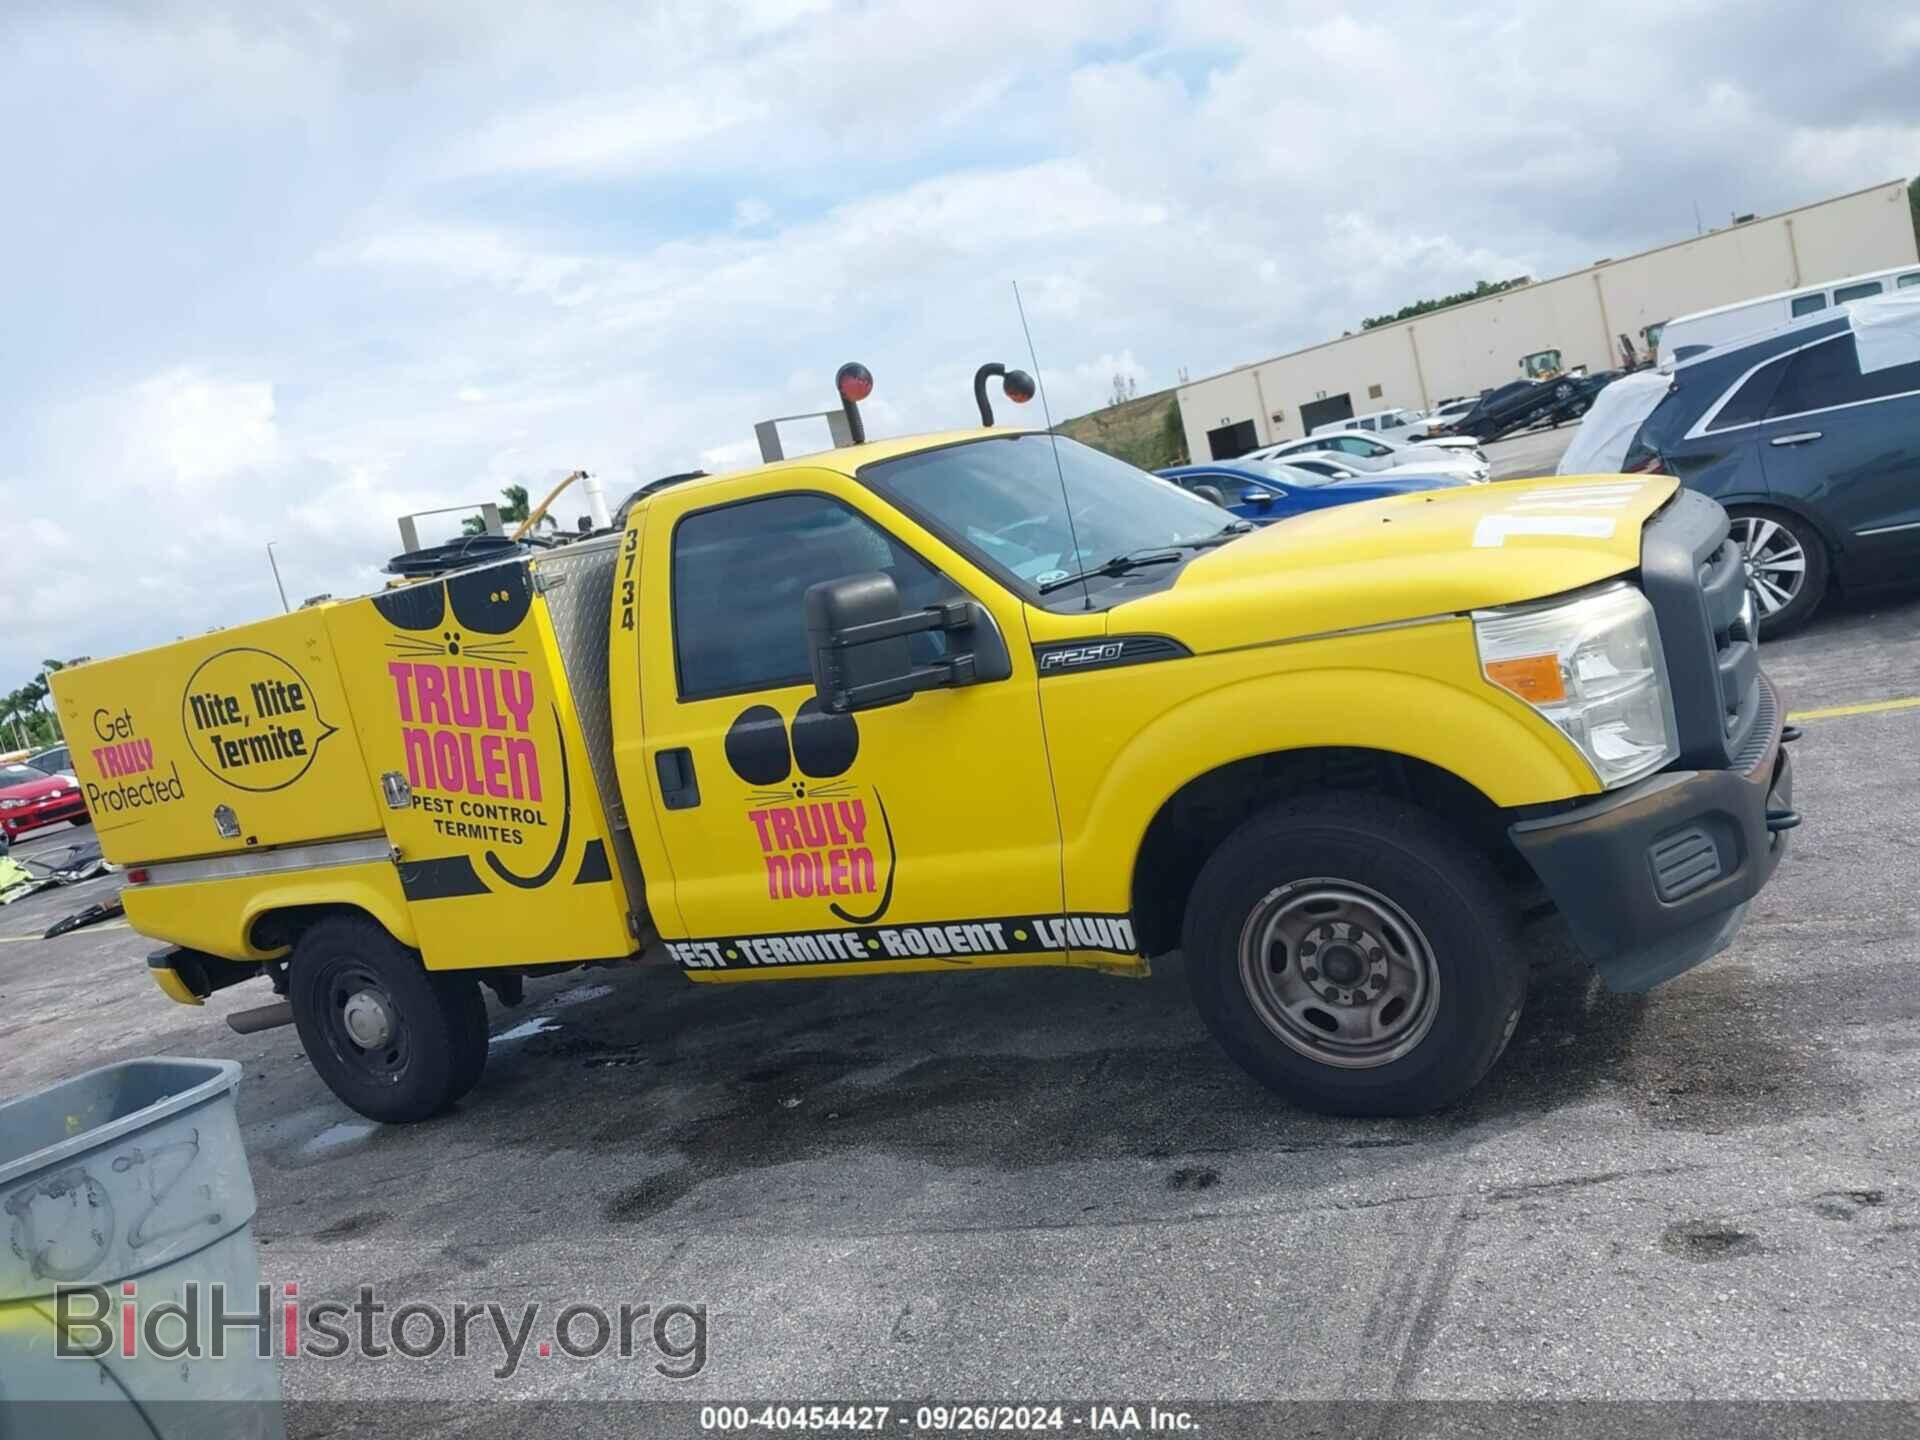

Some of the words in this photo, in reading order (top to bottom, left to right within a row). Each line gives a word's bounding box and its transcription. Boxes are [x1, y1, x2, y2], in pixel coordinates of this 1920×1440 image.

[621, 528, 638, 631] 3734
[190, 693, 250, 730] Nite,
[251, 680, 306, 718] Nite
[388, 662, 534, 732] TRULY
[93, 708, 134, 742] Get
[210, 724, 308, 769] Termite
[92, 738, 154, 780] TRULY
[402, 727, 543, 803] NOLEN
[86, 760, 185, 815] Protected
[411, 795, 454, 813] PEST
[460, 801, 548, 826] CONTROL
[433, 820, 523, 845] TERMITES
[748, 799, 867, 852] TRULY
[766, 847, 878, 900] NOLEN
[735, 931, 869, 966] TERMITE
[877, 923, 1009, 957] RODENT
[1032, 917, 1137, 951] LAWN
